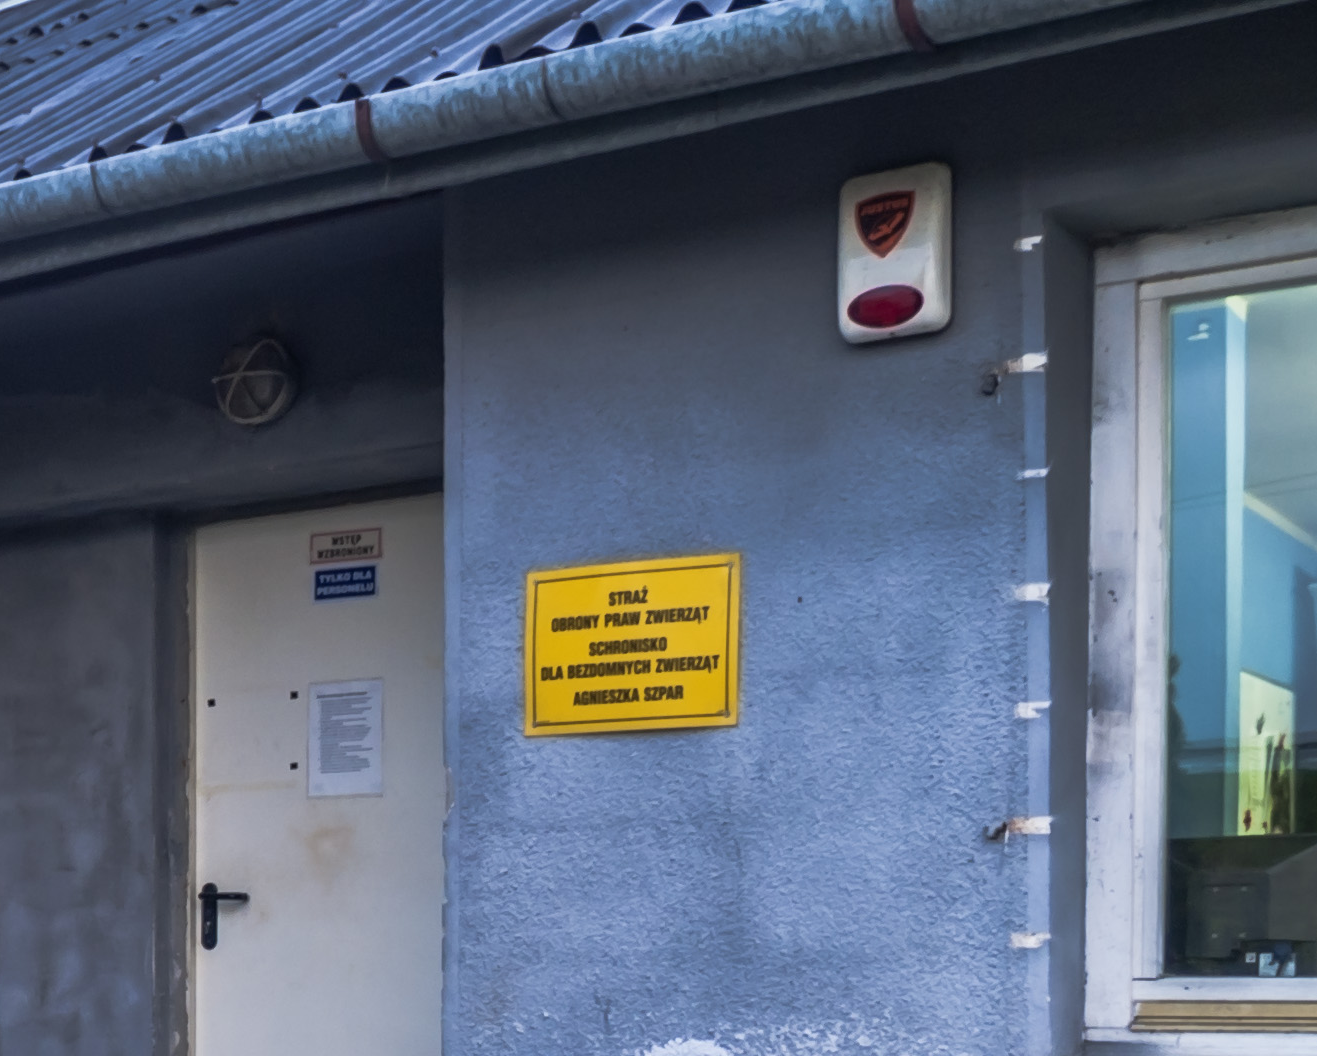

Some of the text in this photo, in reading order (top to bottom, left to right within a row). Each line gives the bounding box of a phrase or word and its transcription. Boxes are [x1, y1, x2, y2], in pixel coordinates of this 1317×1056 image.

[319, 572, 351, 584] TYLKO
[608, 585, 649, 607] STRAŻ
[551, 606, 710, 633] OBRONY PRAW ZWIERZĄT
[588, 637, 668, 657] SCHRONISKO
[540, 654, 720, 681] DLA BEZDOMNYCH ZWIERZĄT
[573, 685, 684, 706] AGNIESZKA SZPAR
